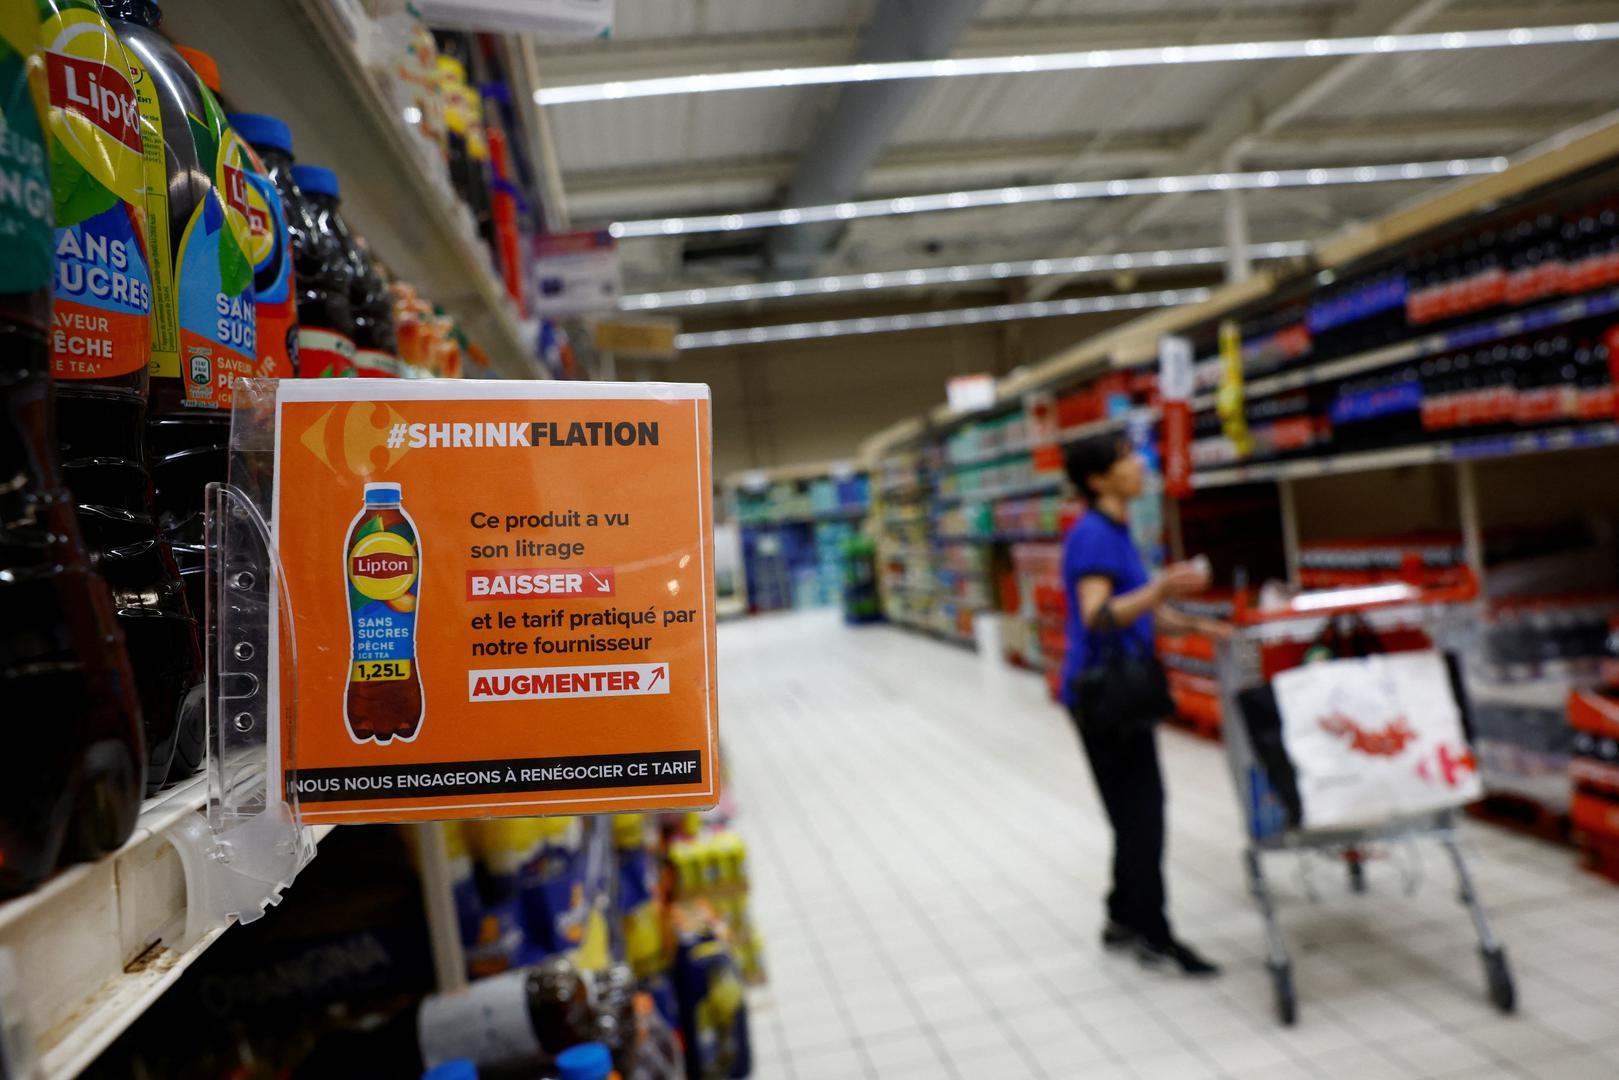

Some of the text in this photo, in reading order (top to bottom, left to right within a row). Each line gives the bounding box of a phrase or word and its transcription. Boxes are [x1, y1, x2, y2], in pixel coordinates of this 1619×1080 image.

[64, 65, 140, 135] Lipto
[57, 229, 127, 268] ANS
[60, 262, 149, 310] UCRES
[52, 312, 109, 333] AVEUR
[217, 318, 256, 348] SUC
[52, 330, 113, 358] ÊCHE
[387, 421, 659, 449] #SHRINKFLATION
[470, 510, 630, 532] Ce produit a vu
[470, 539, 585, 560] son litrage
[358, 557, 408, 574] Lipton
[472, 573, 583, 596] BAISSER
[358, 617, 393, 628] SANS
[471, 606, 697, 631] et le tarif pratiqué par
[358, 628, 409, 639] SUCRES
[358, 639, 395, 651] PÊCHE
[374, 651, 390, 659] TEA
[472, 634, 653, 657] notre fournisseur
[358, 663, 406, 680] 1,25L
[472, 670, 641, 697] AUGMENTER
[290, 760, 697, 793] NOUS NOUS ENGAGEONS À RENÉGOCIER CE TARIF
